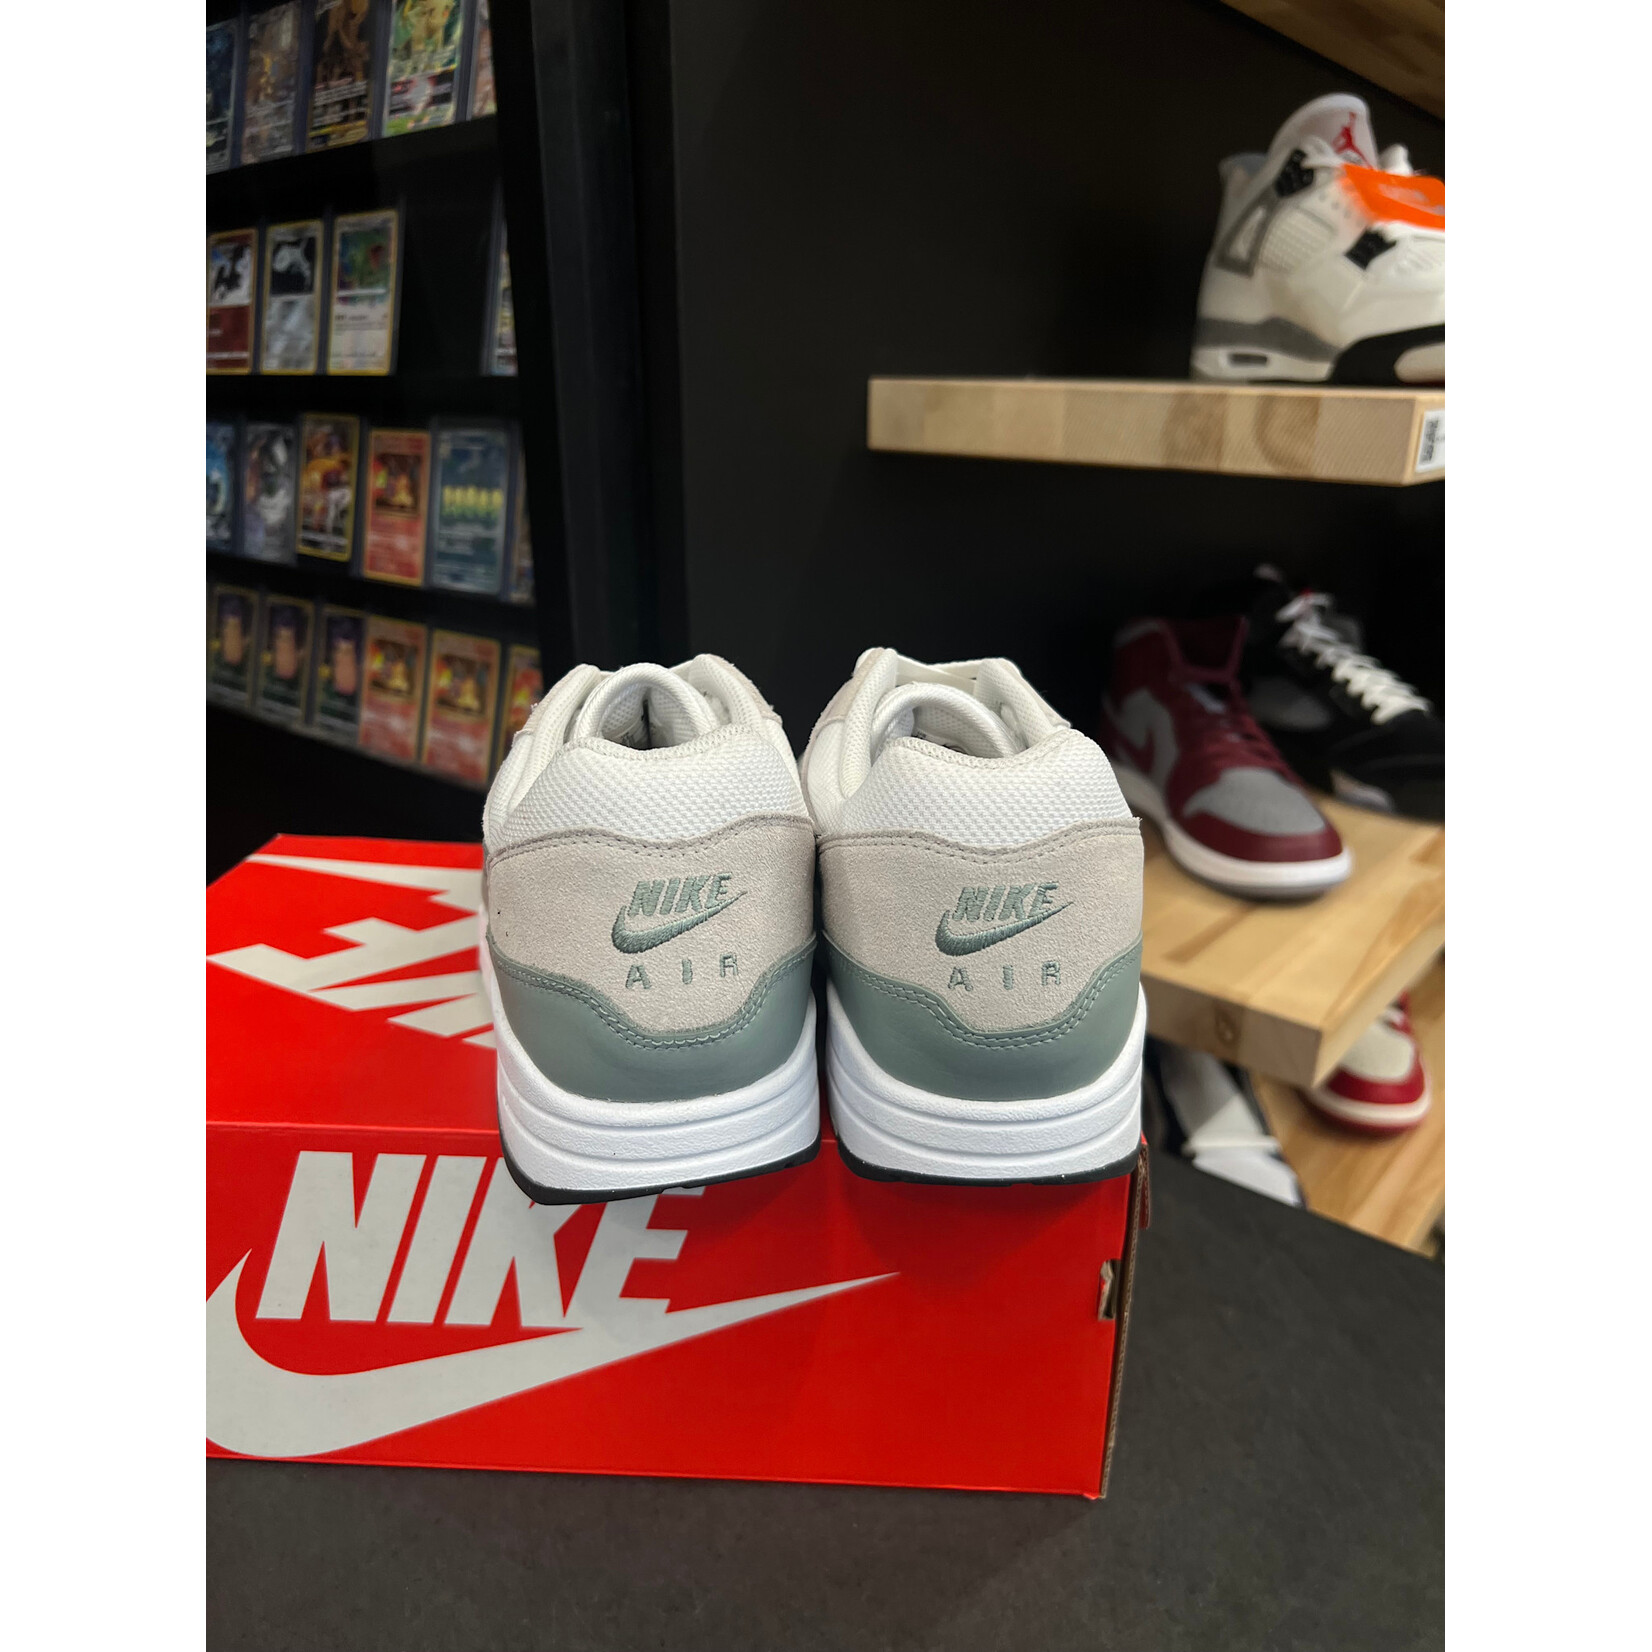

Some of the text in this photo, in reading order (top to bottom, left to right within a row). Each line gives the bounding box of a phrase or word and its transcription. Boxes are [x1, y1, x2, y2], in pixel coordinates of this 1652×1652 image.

[627, 872, 733, 917] NIKE
[952, 881, 1060, 922] NIKE
[625, 951, 739, 990] AIR
[947, 960, 1062, 992] AIR
[255, 1151, 706, 1329] NIKE
